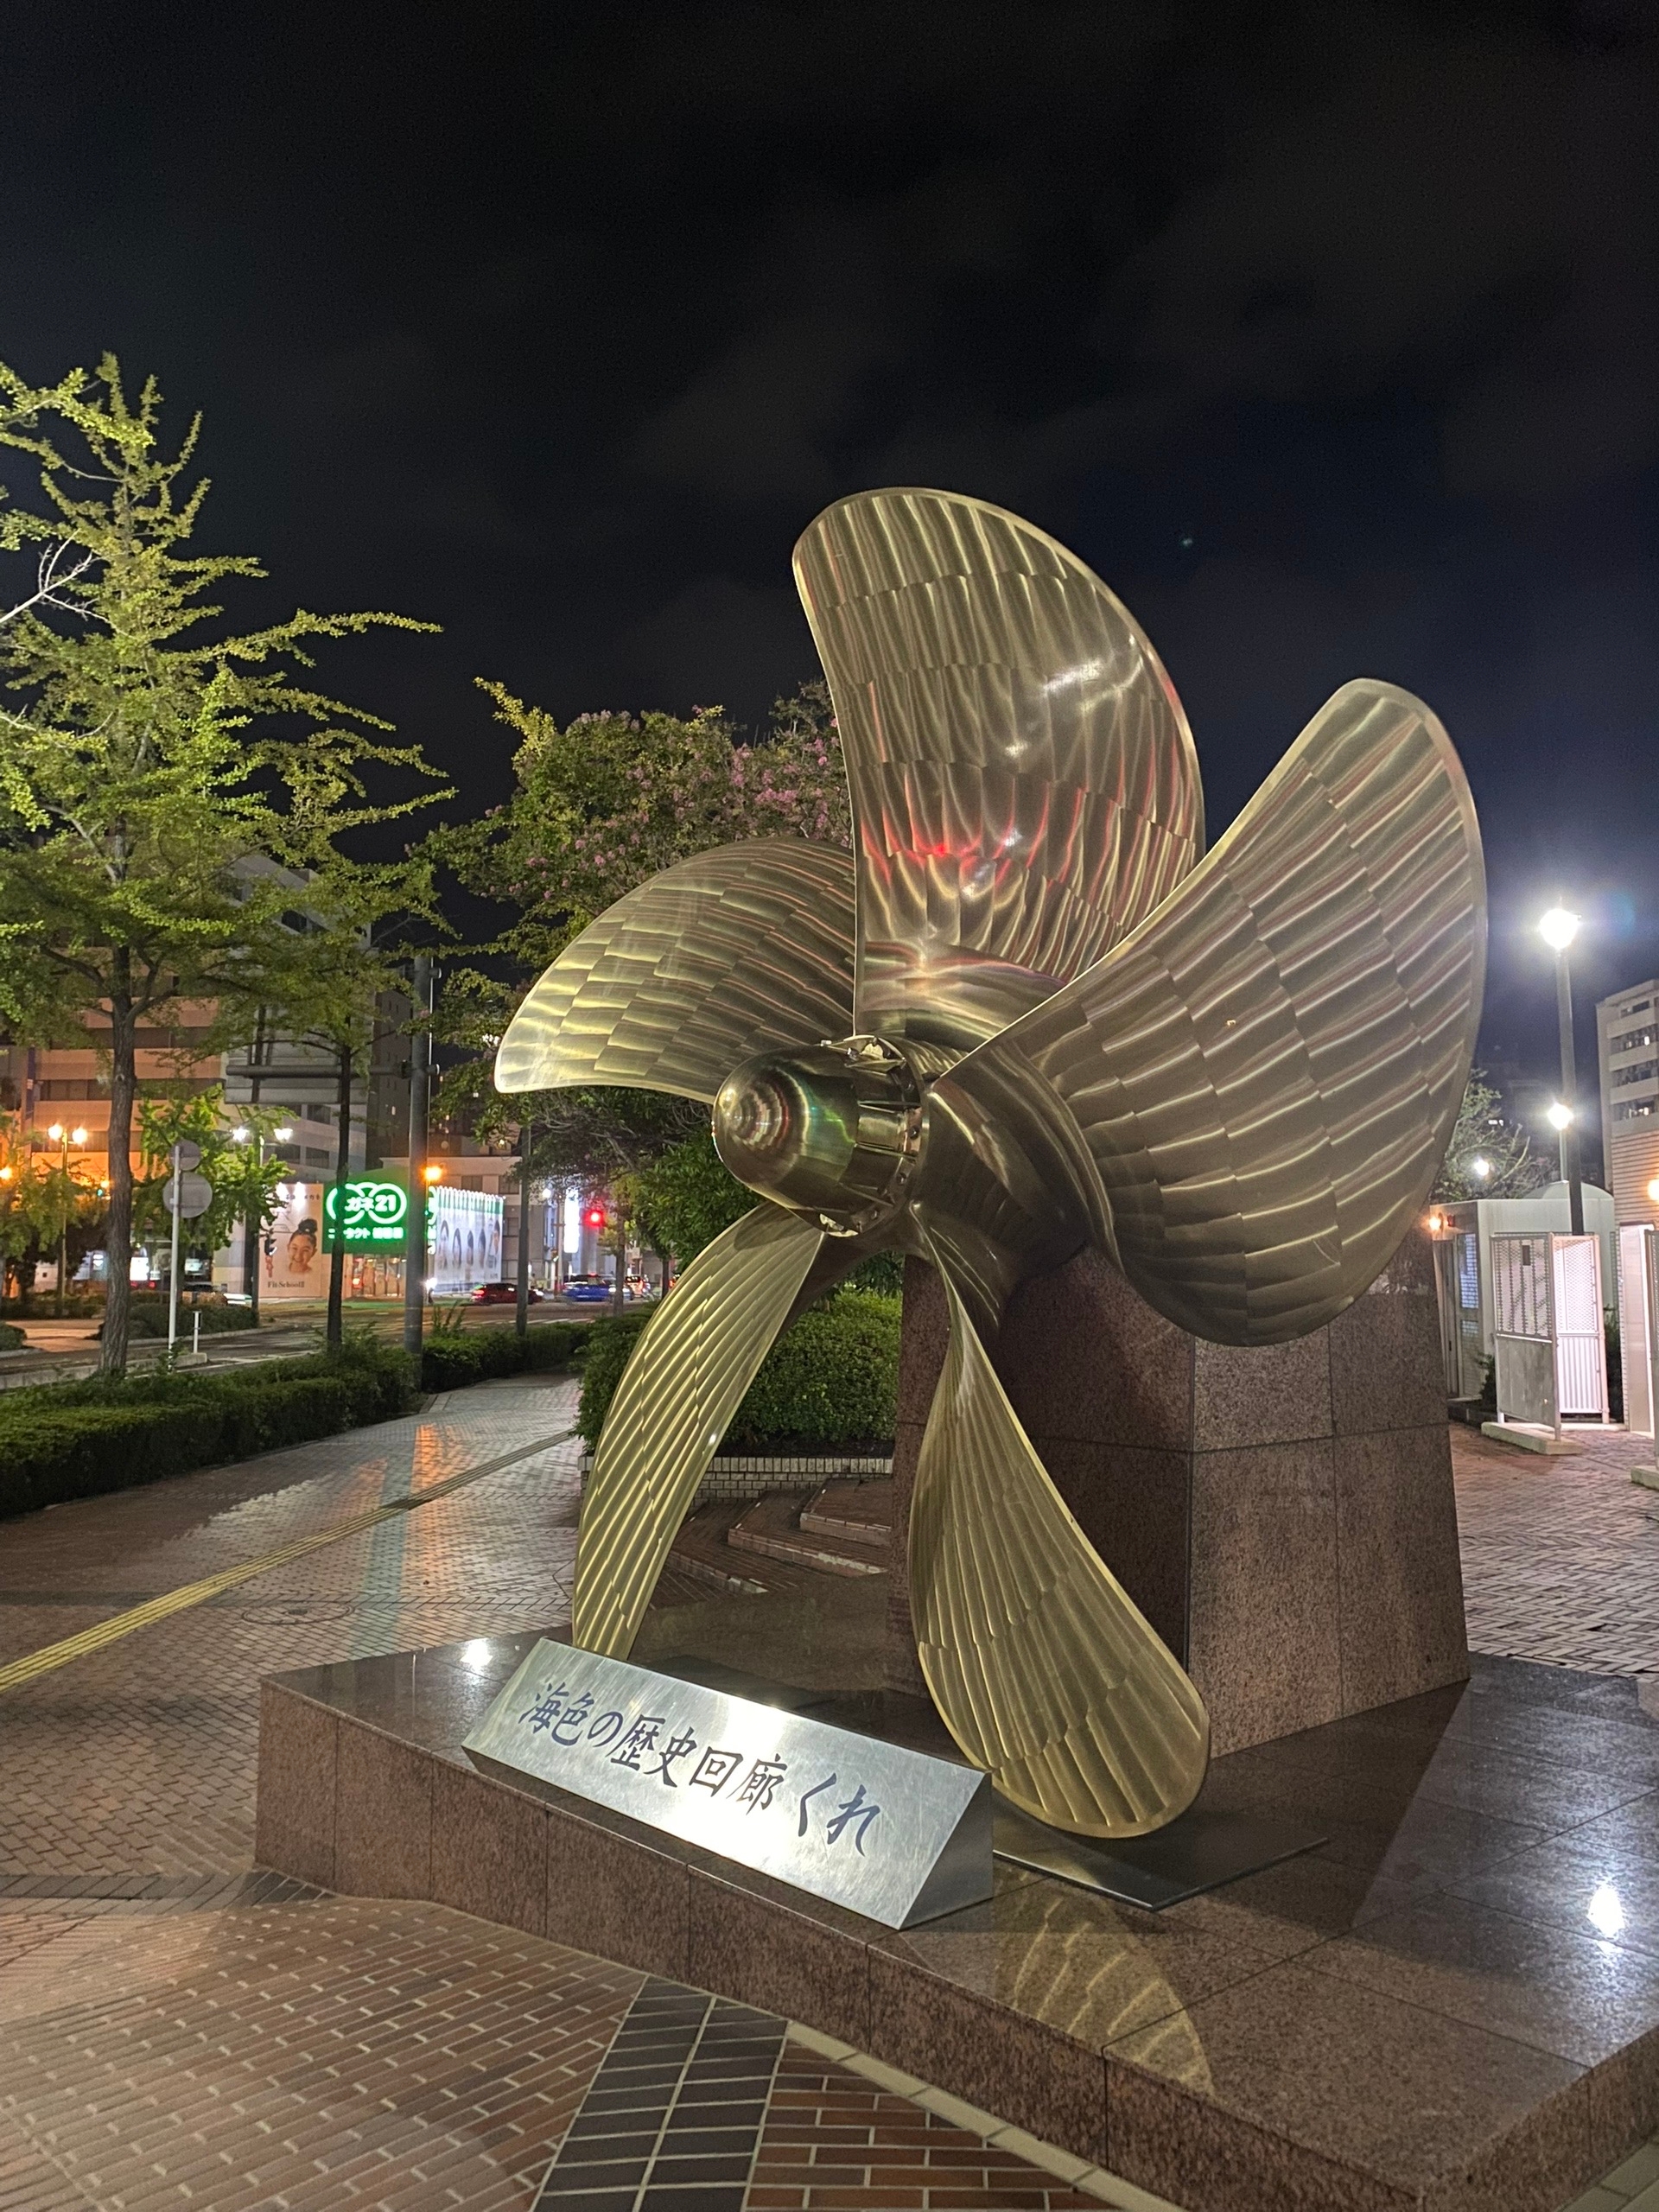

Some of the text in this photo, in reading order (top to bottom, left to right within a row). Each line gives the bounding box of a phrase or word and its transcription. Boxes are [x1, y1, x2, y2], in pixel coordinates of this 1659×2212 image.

[345, 1194, 397, 1212] ガネ21
[518, 1681, 880, 1857] 海色の歴史回廊 くれ
